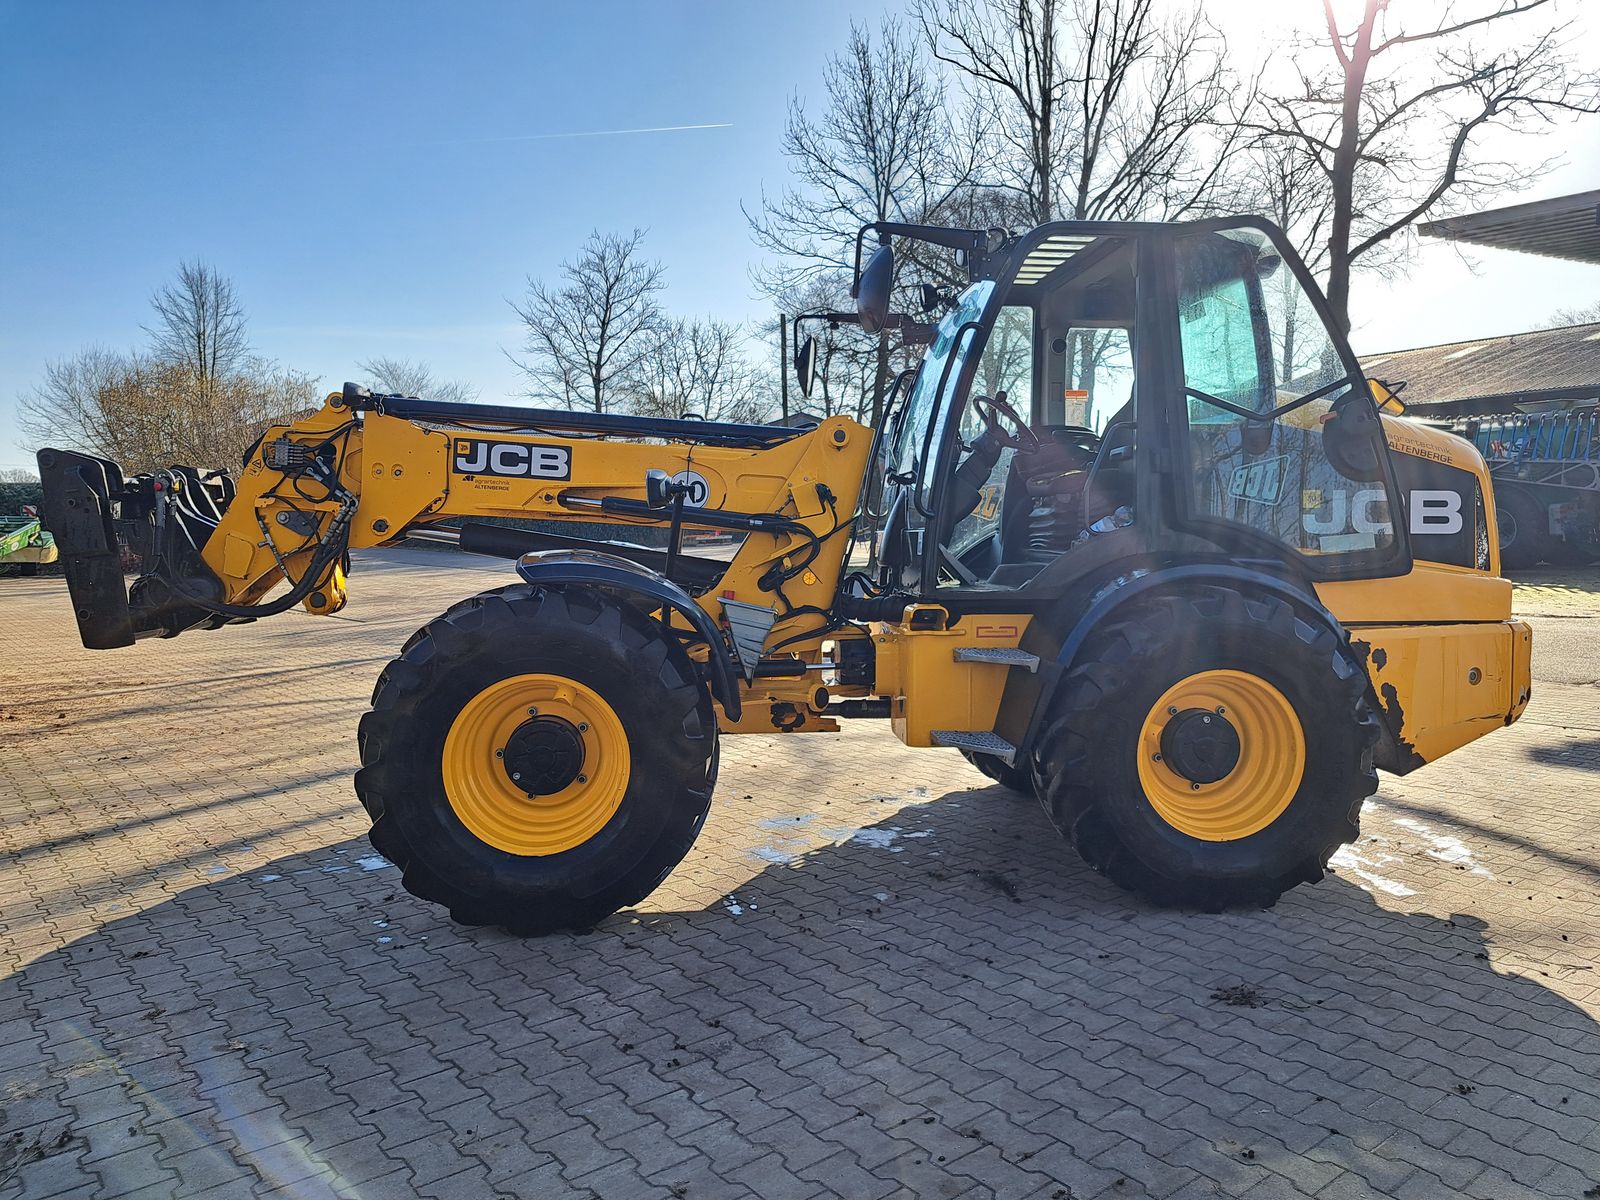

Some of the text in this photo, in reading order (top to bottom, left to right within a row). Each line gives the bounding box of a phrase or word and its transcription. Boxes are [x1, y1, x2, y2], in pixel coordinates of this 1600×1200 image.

[456, 442, 569, 478] JCB
[1388, 441, 1453, 464] ALTENBERGE
[474, 484, 510, 492] ALTENBERGE
[1302, 489, 1463, 535] JCB
